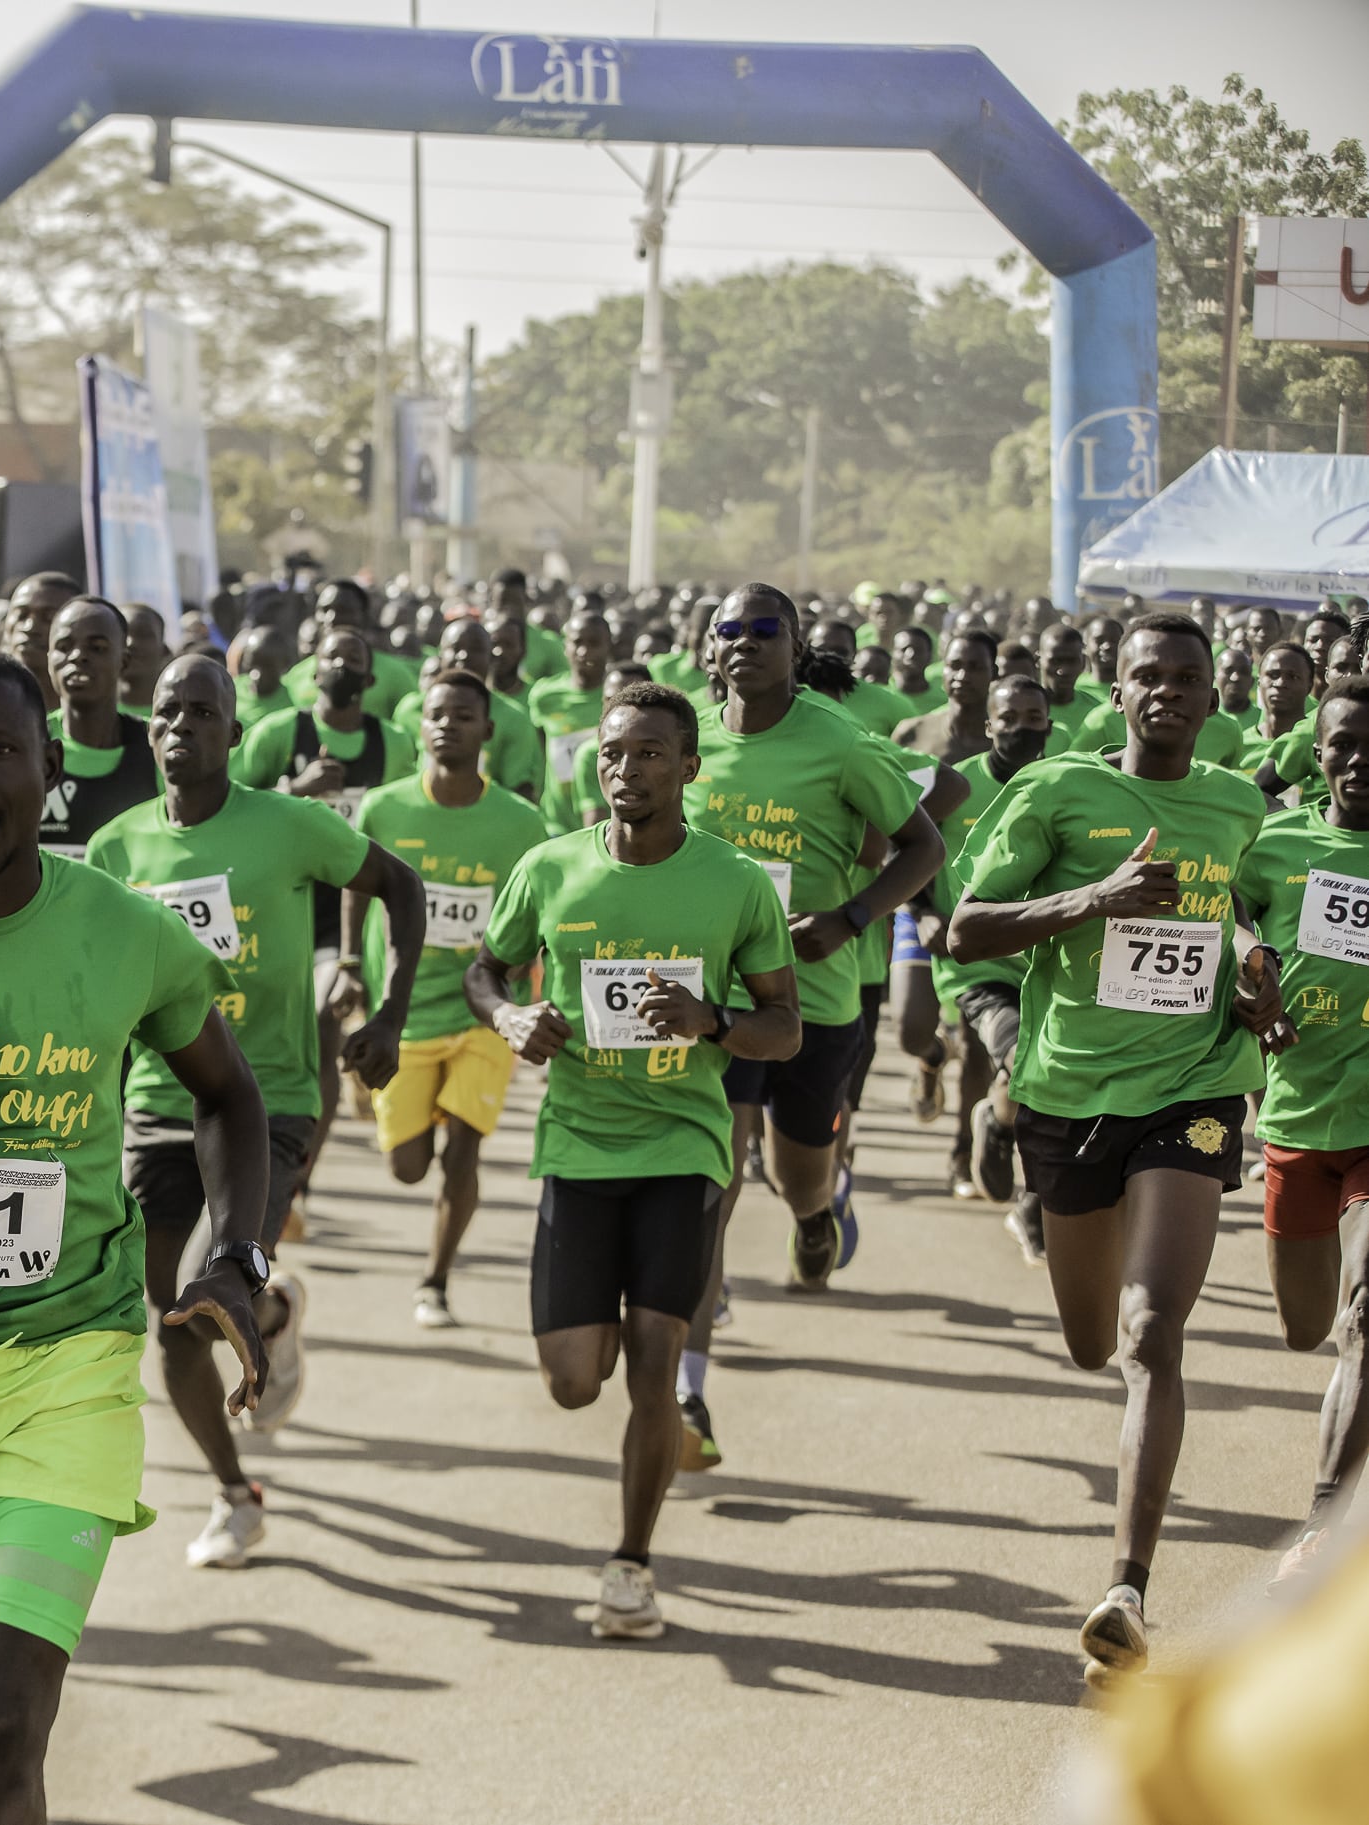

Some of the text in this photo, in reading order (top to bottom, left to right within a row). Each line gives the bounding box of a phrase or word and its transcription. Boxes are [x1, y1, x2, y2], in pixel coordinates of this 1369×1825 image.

[1178, 860, 1198, 883] 10
[1320, 878, 1341, 890] 10KM
[1341, 881, 1352, 892] DE
[426, 900, 478, 922] 140
[1118, 924, 1184, 939] 10KM DE OUAGA
[1128, 940, 1205, 977] 755
[594, 967, 617, 976] 10KM
[36, 1032, 98, 1076] km
[0, 1089, 93, 1138] OUAGA
